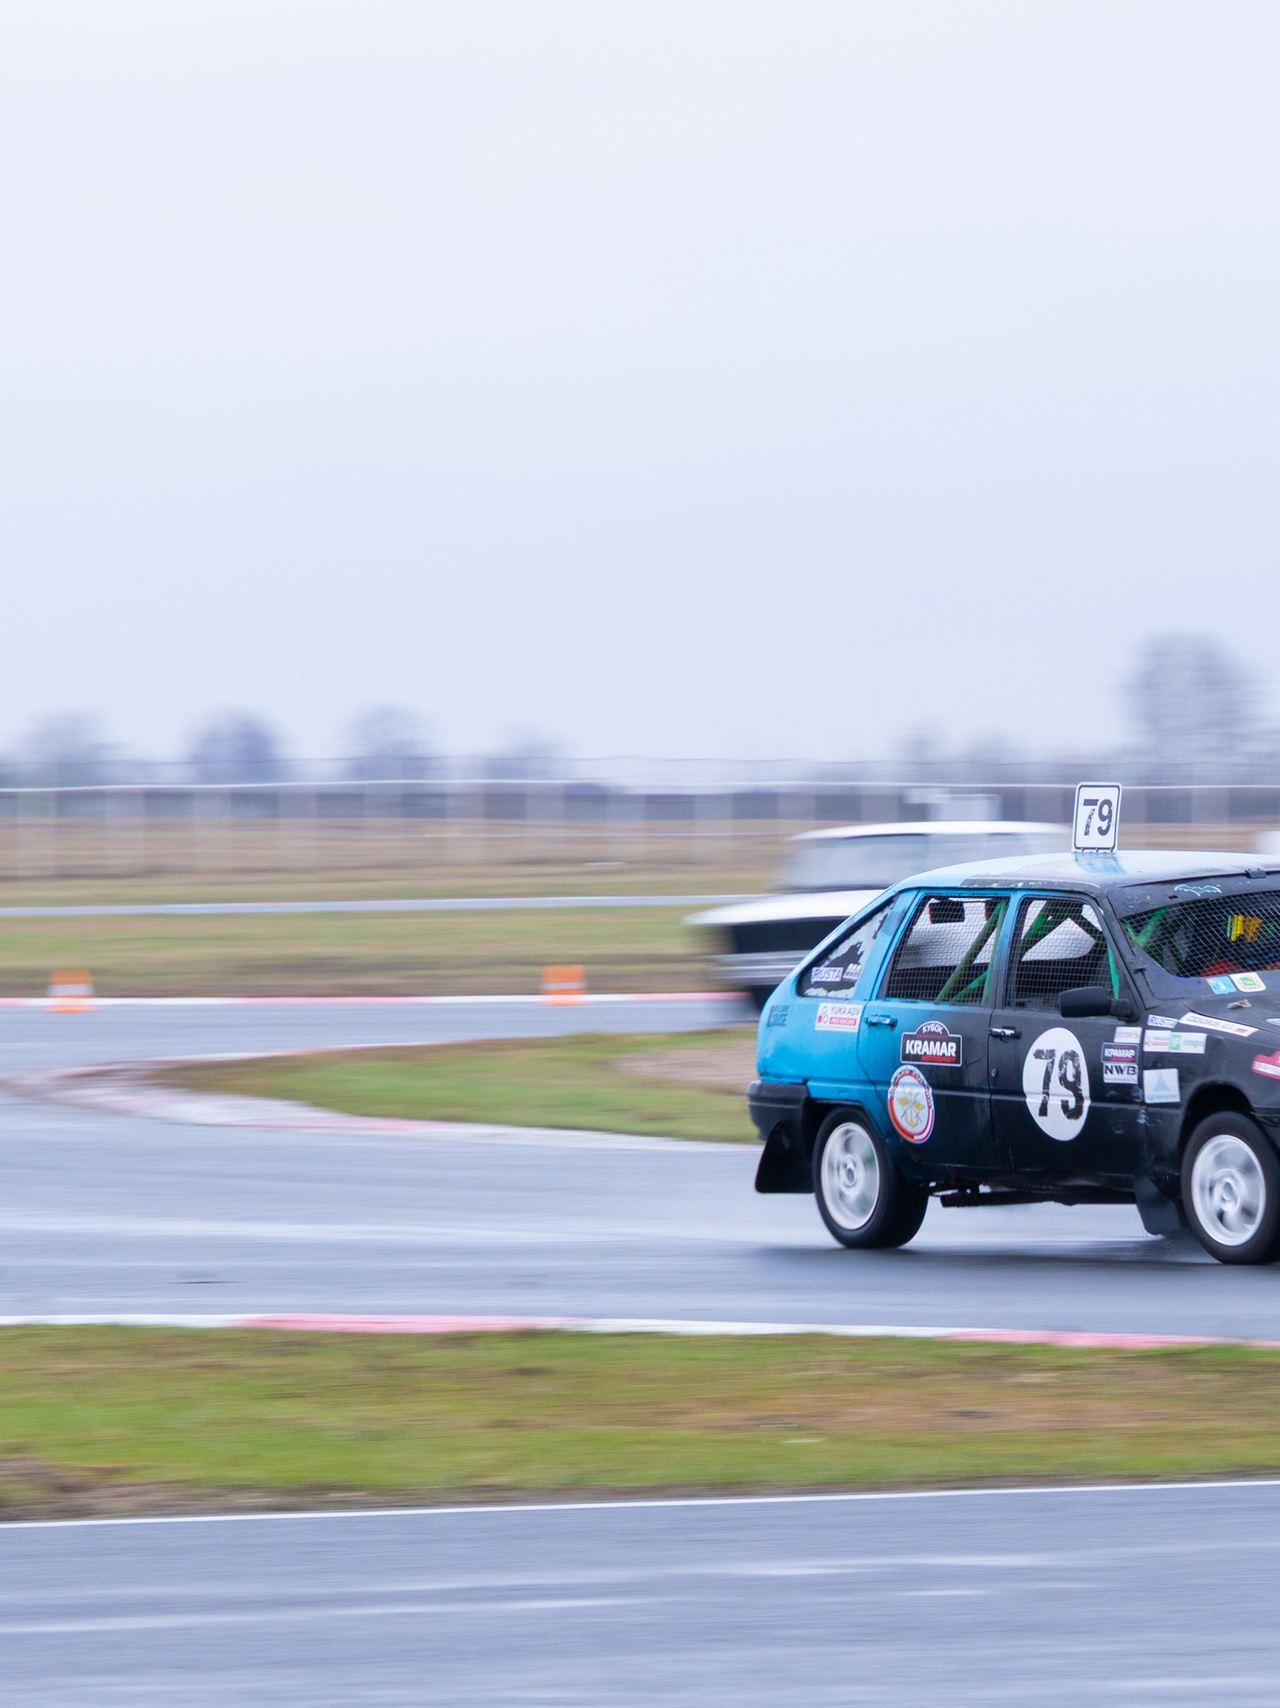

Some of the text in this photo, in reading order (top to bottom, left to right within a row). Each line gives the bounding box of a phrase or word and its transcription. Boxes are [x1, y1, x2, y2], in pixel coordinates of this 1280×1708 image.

[1083, 798, 1113, 836] 79
[922, 1023, 944, 1035] КУБОК
[905, 1039, 957, 1057] KRAMAR
[1104, 1064, 1137, 1076] NWB
[1033, 1048, 1085, 1121] 79
